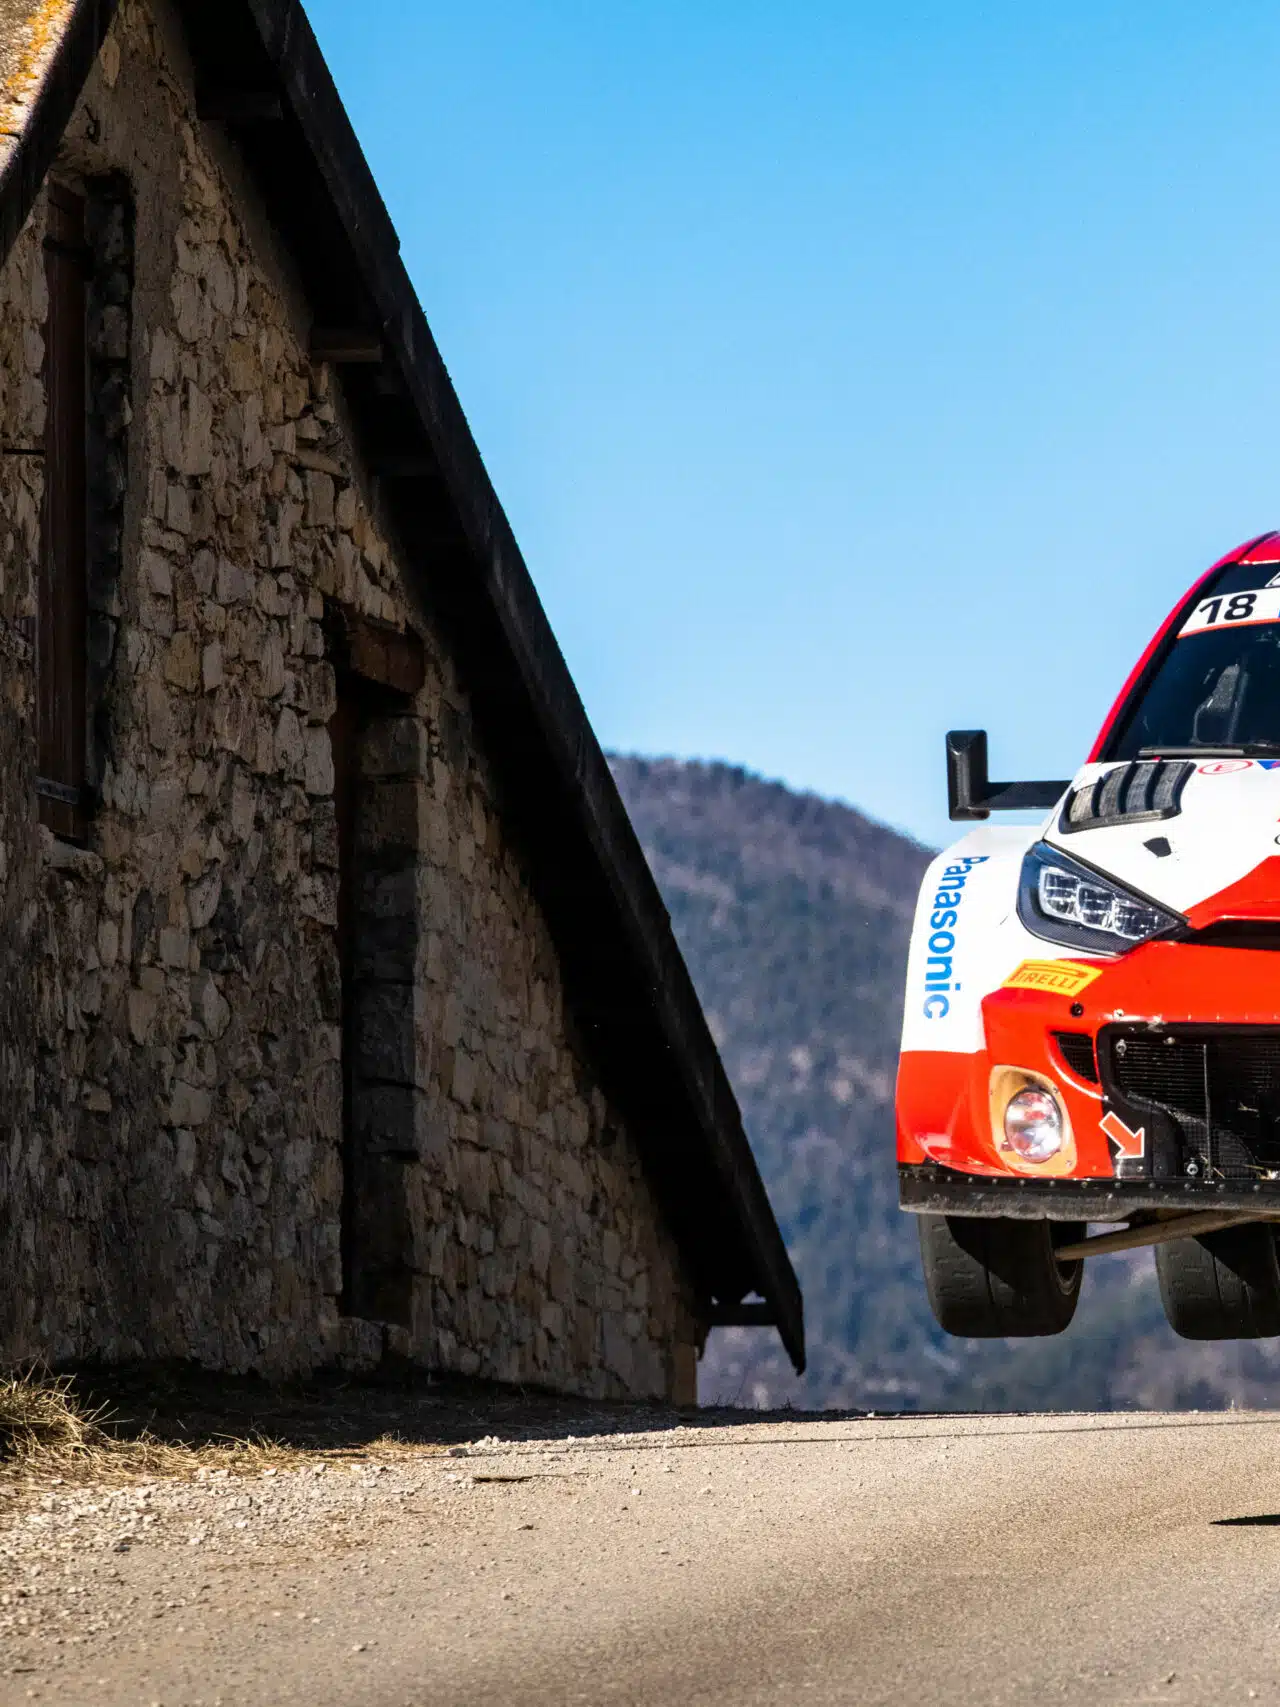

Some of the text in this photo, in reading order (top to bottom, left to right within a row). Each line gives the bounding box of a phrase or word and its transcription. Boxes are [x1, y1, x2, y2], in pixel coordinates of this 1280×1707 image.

[1198, 593, 1258, 624] 18
[923, 856, 991, 1019] Panasonic
[1007, 963, 1089, 989] PIRELLI
